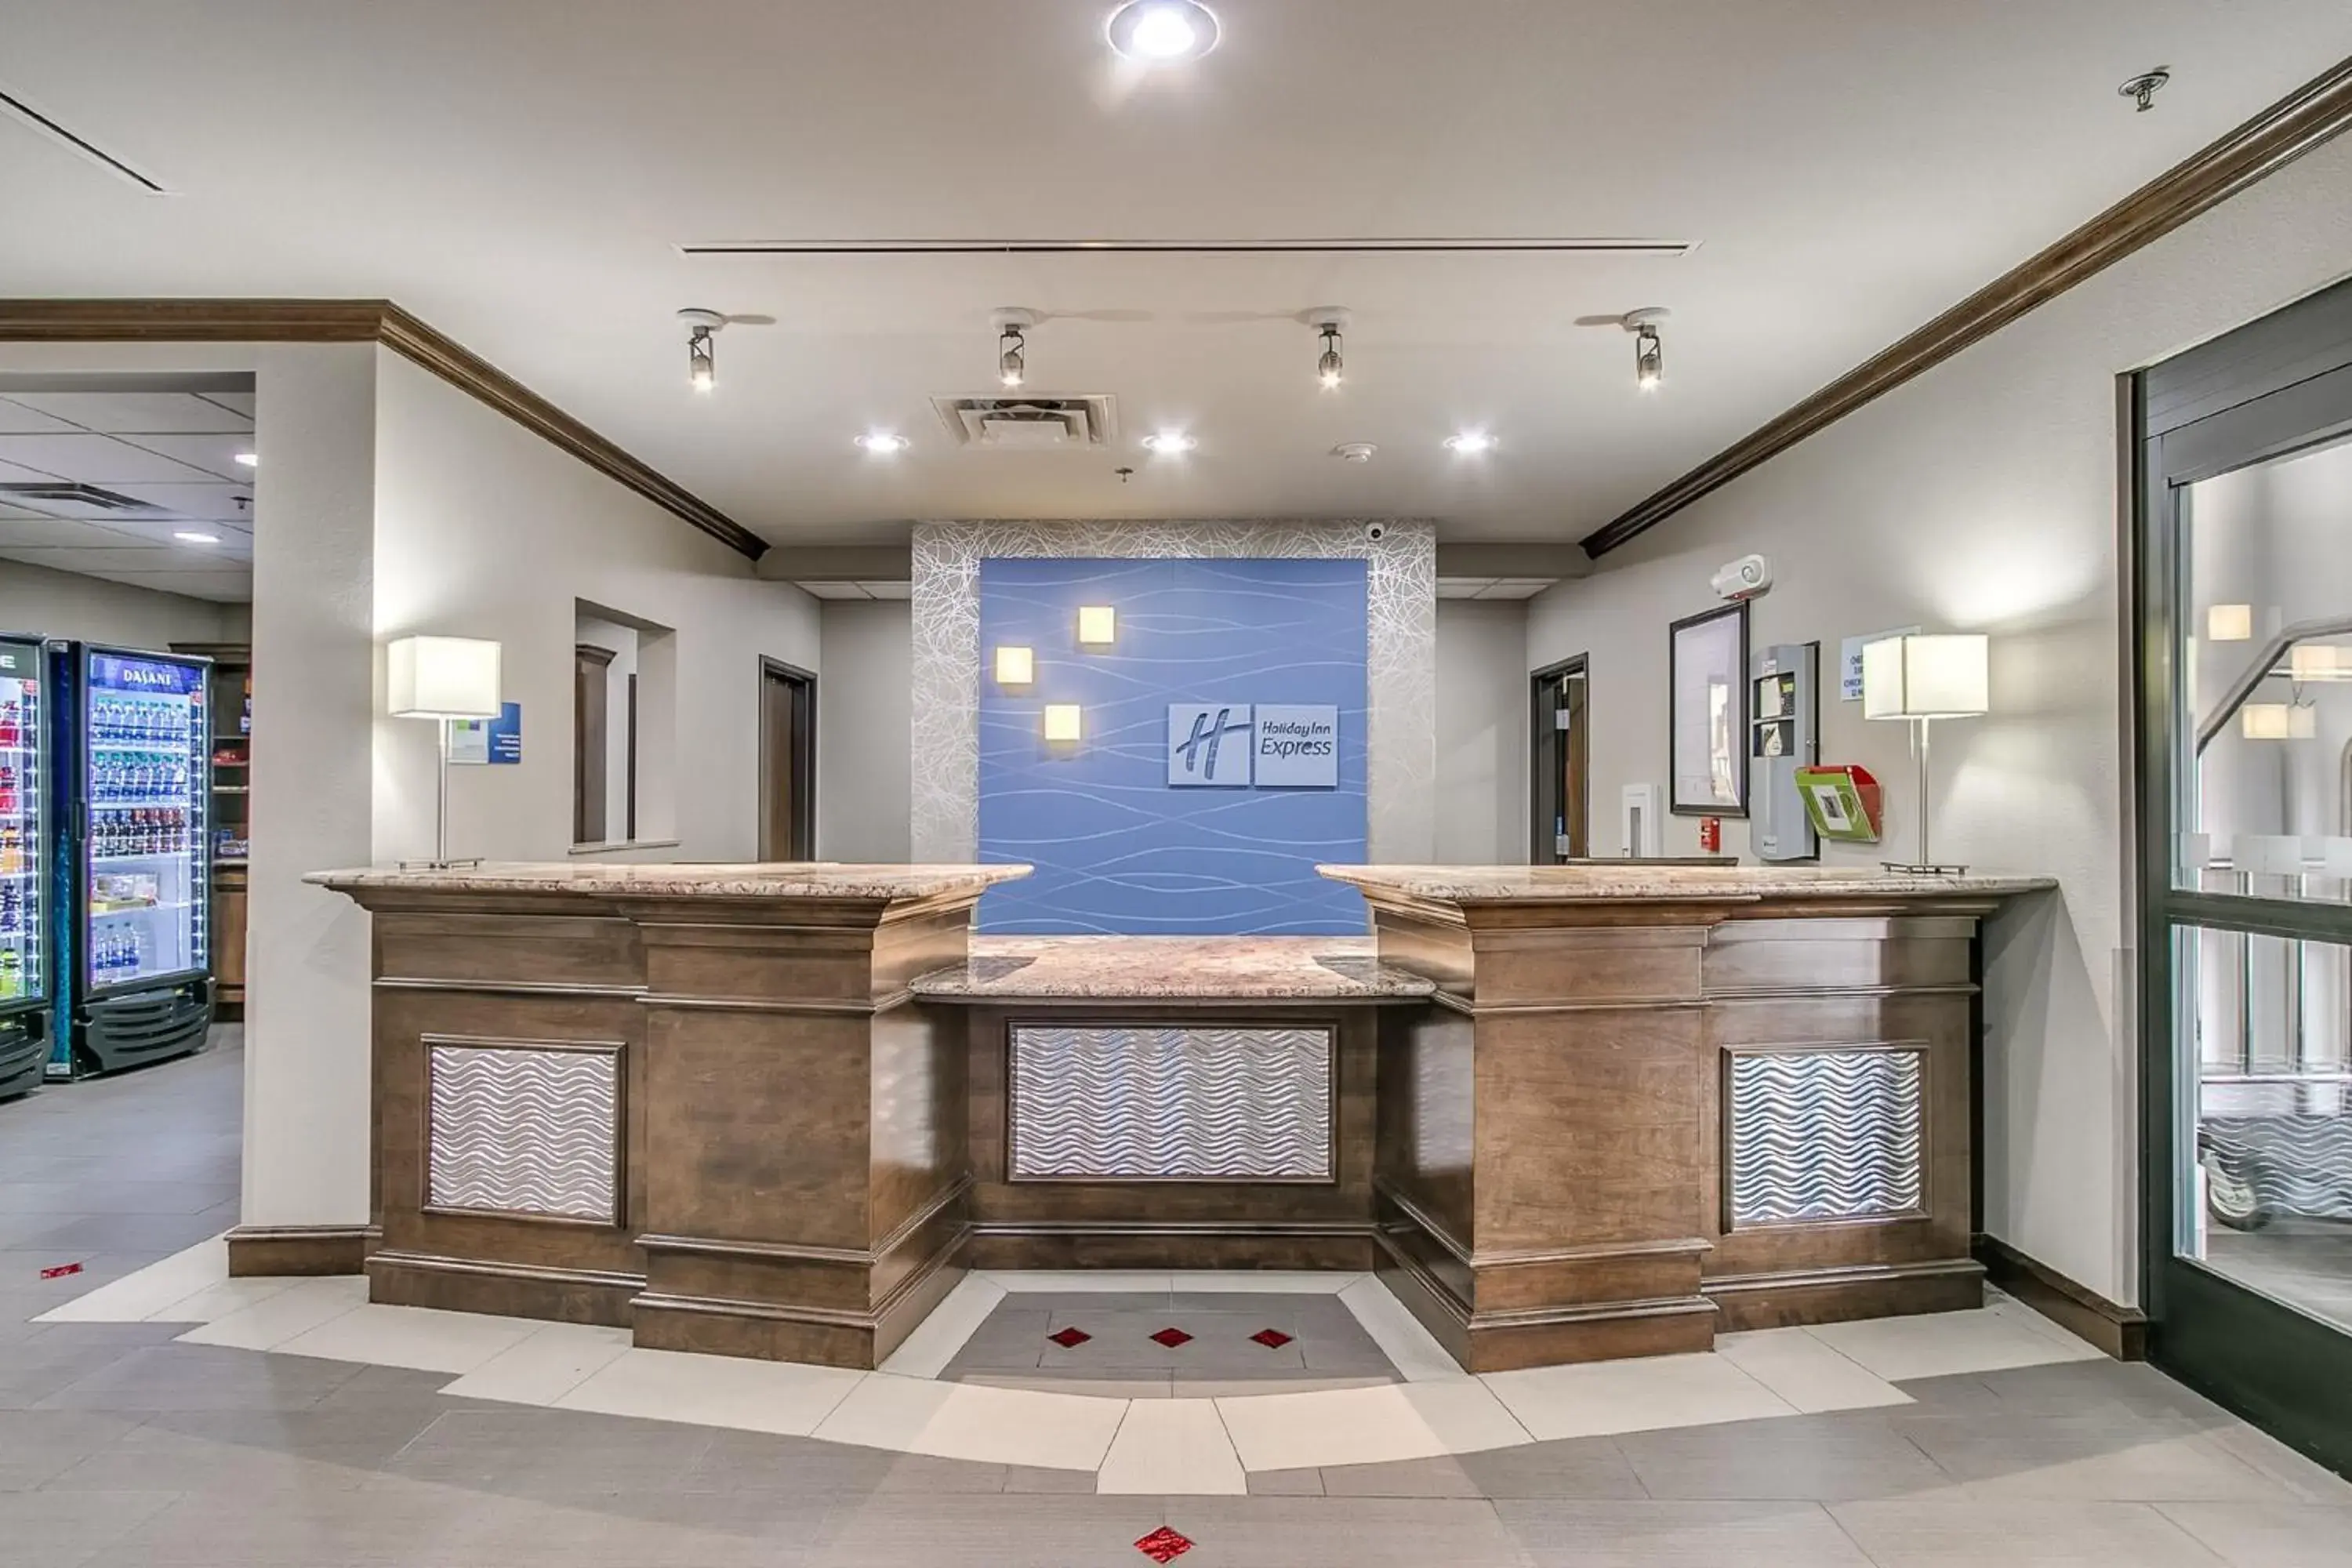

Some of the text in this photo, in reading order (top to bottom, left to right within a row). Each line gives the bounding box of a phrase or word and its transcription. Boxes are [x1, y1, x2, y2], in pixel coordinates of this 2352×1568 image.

[123, 669, 171, 685] DASANI
[1262, 721, 1330, 737] Holiday Inn
[1261, 738, 1332, 759] Express
